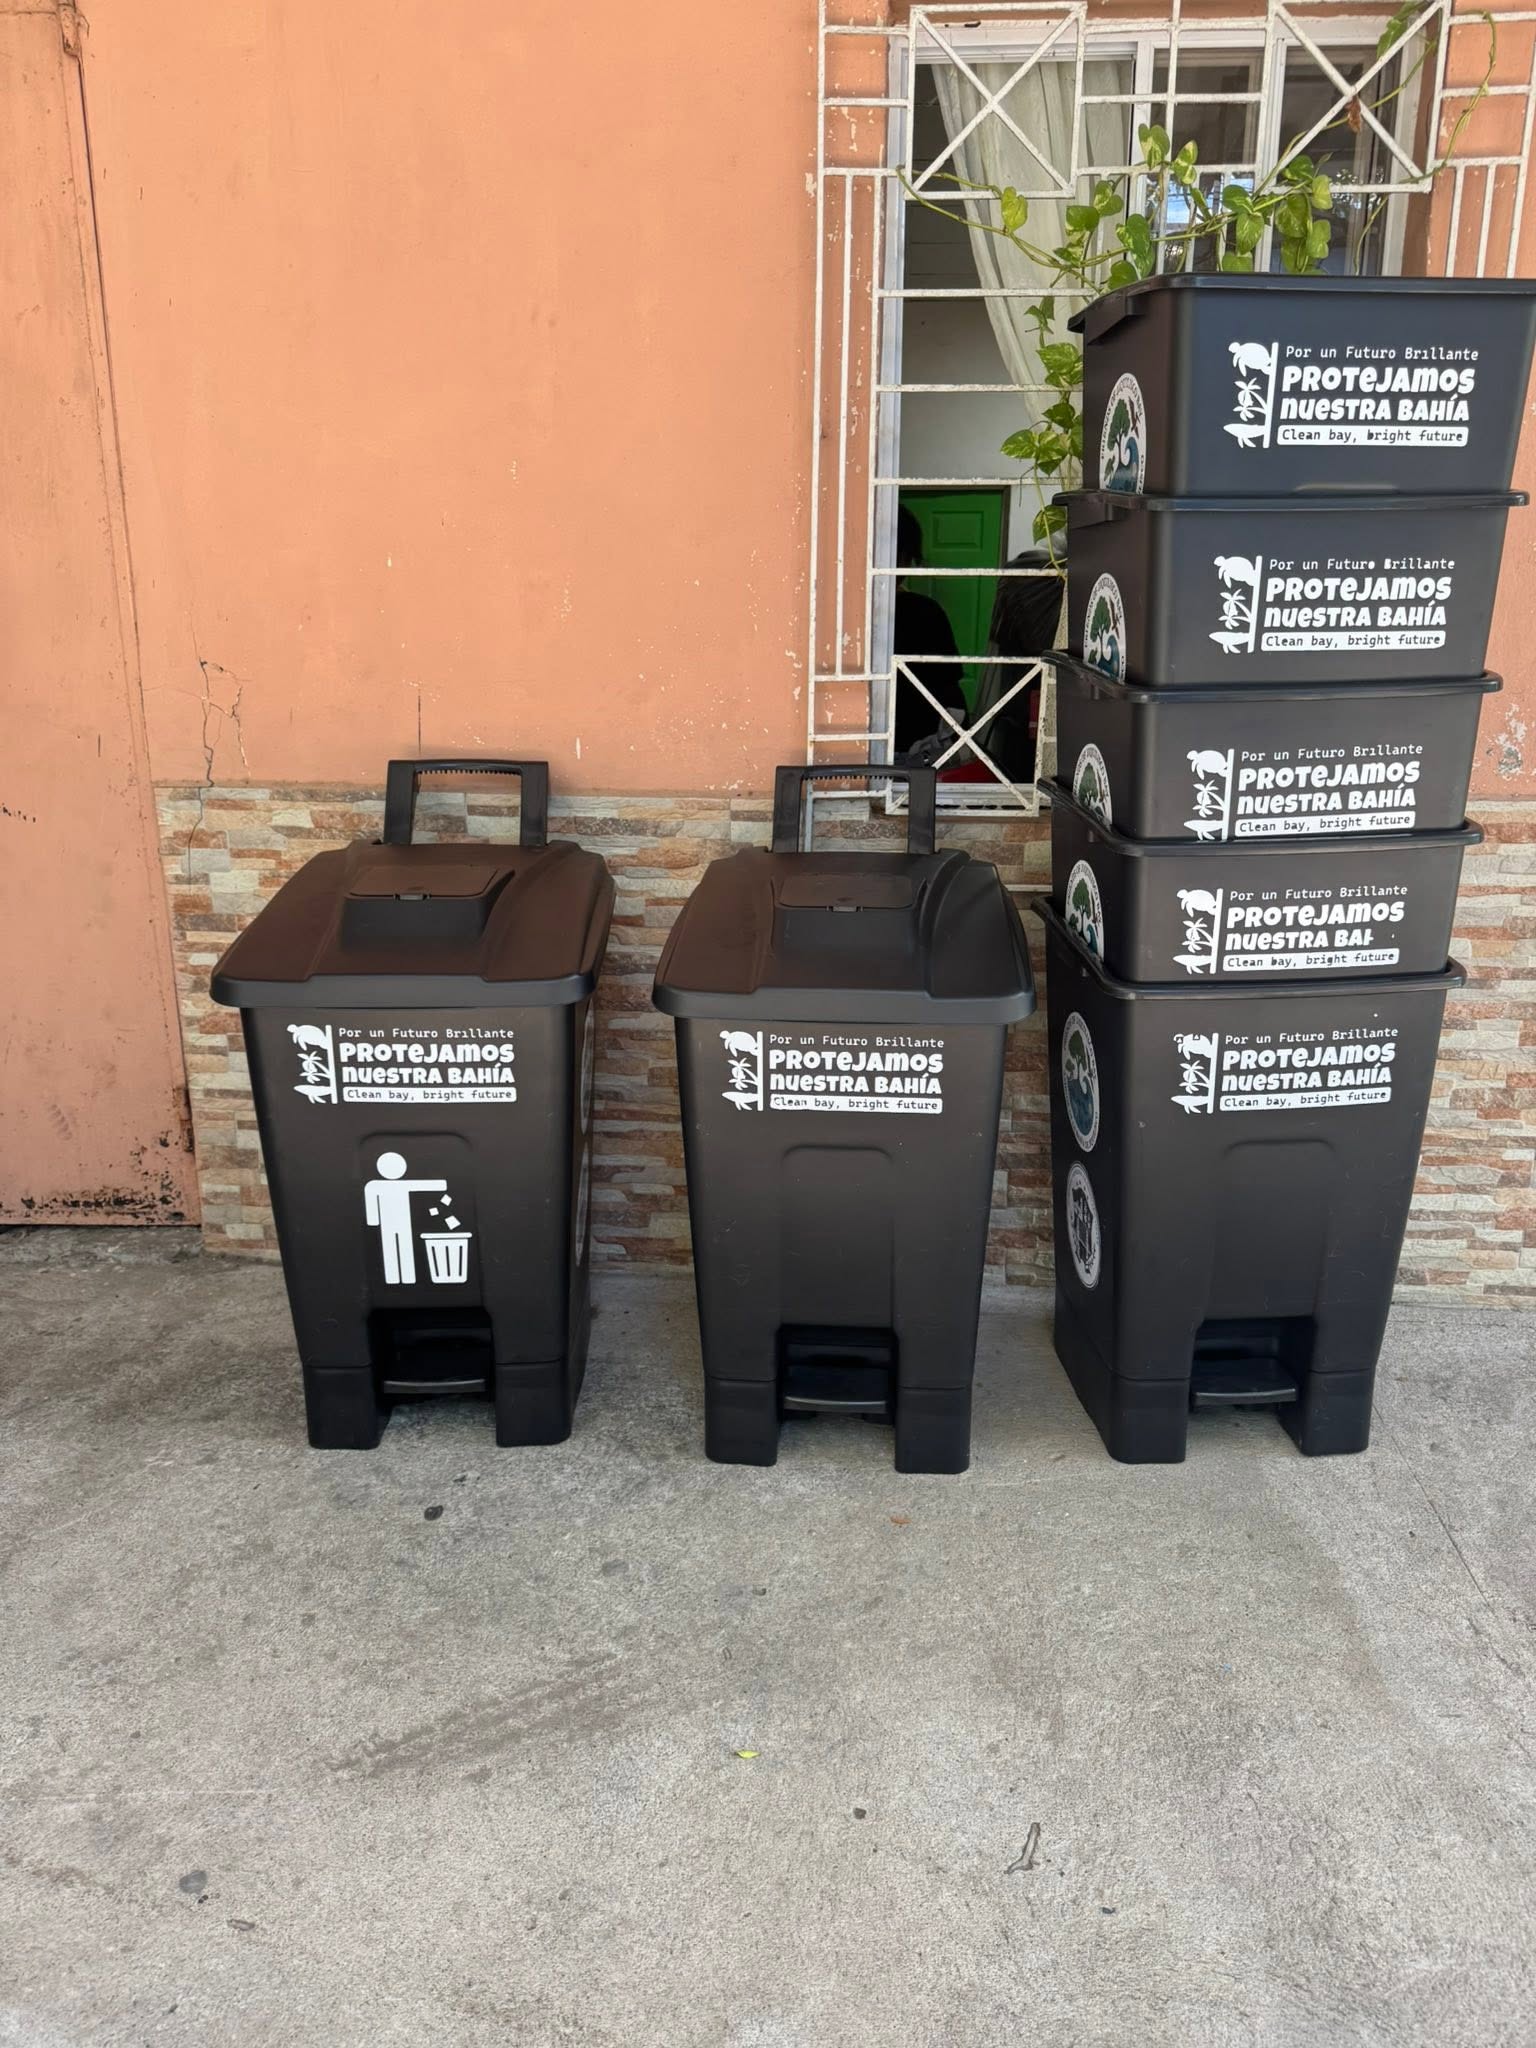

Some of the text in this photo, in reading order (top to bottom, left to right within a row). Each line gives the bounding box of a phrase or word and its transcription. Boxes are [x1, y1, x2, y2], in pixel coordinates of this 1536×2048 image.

[1286, 346, 1479, 360] Por un Futuro Brillante
[1282, 429, 1463, 443] Clean bay, bright future
[1270, 558, 1455, 570] Por un Futuro Brillante
[1266, 634, 1440, 647] Clean bay, bright future
[1242, 744, 1423, 762] Por un Futuro Brillante
[1239, 815, 1411, 832] Clean bay, bright future
[1230, 886, 1408, 901] Por un Futuro Brillante
[1228, 952, 1394, 967] Clean bay, bright future
[339, 1028, 514, 1038] Por un Futuro Brillante
[1226, 1028, 1398, 1045] Por un Futuro Brillante
[770, 1035, 944, 1048] Por un Futuro Brillante
[347, 1090, 512, 1101] Clean bay, bright future
[1224, 1092, 1387, 1107] Clean bay, bright future
[814, 1098, 840, 1109] bay,
[849, 1099, 889, 1110] bright
[897, 1100, 938, 1109] future
